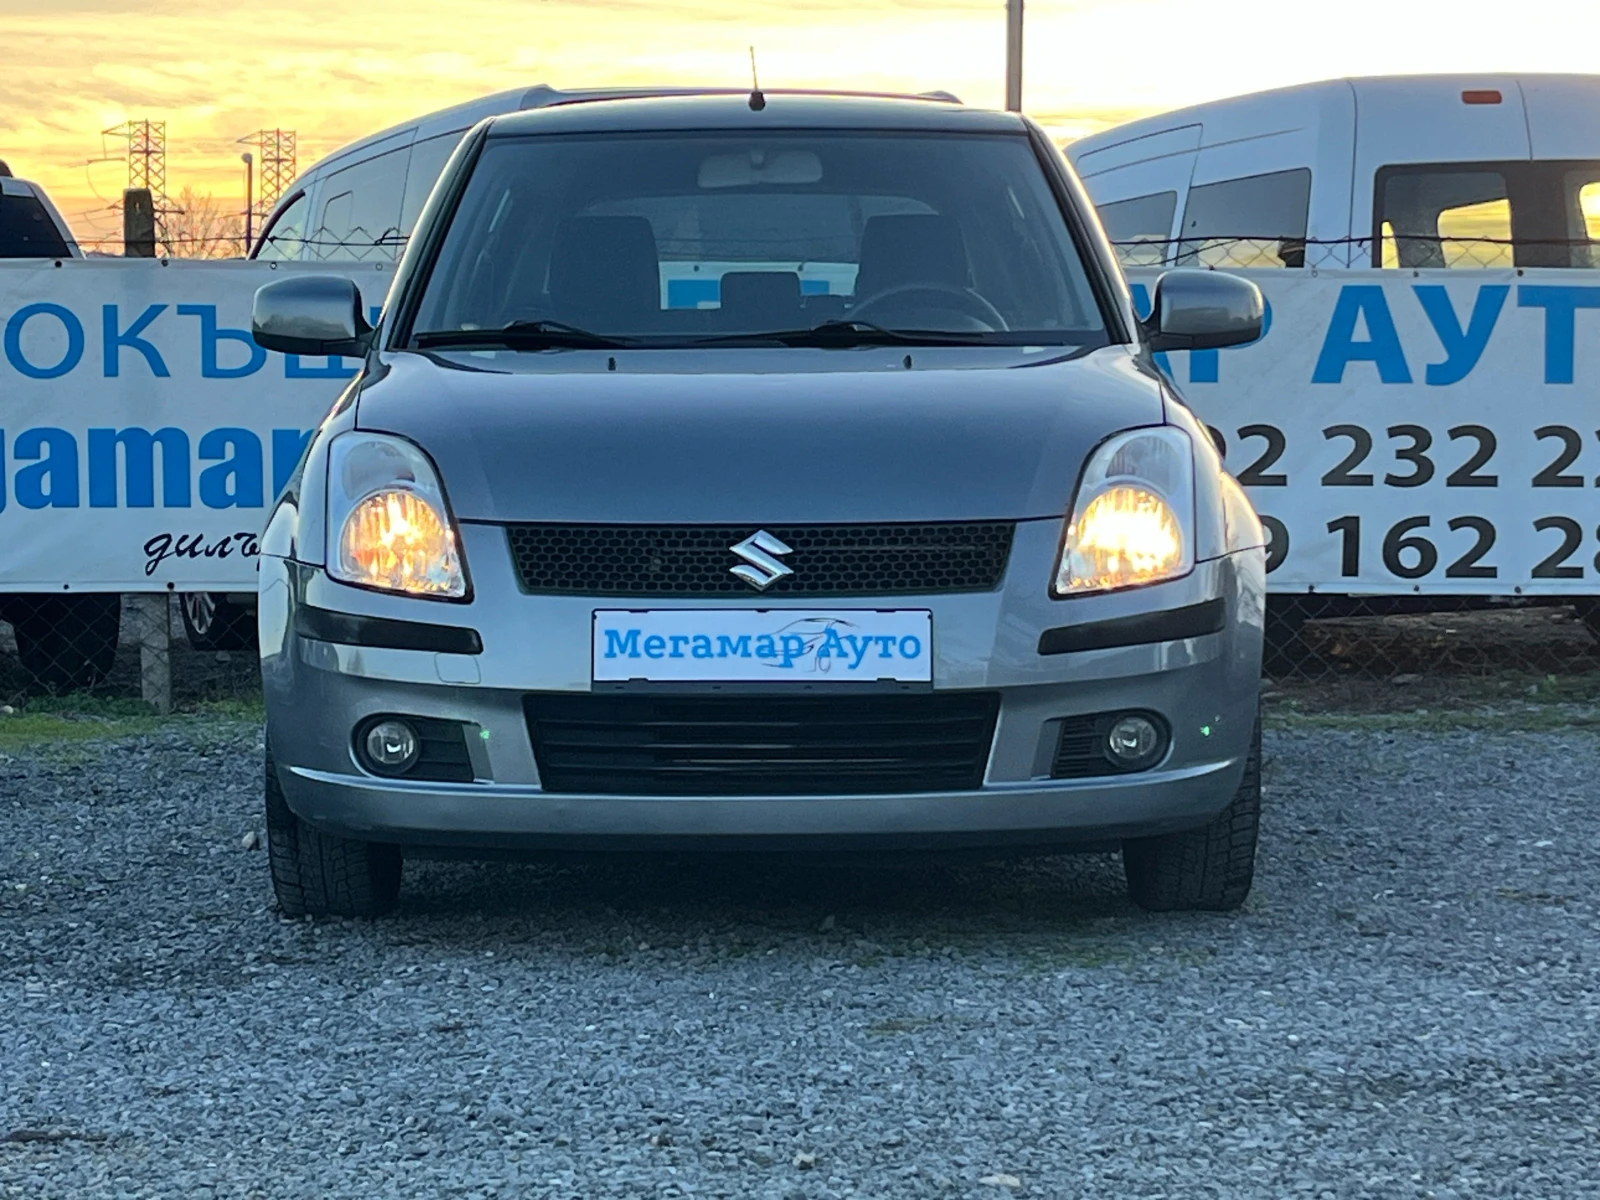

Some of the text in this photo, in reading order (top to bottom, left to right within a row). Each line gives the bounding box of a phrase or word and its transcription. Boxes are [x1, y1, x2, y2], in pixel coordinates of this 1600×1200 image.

[1311, 285, 1600, 386] АУТ
[1321, 424, 1498, 488] 232
[1531, 424, 1600, 488] 2
[143, 532, 261, 576] дилъ
[1326, 515, 1498, 579] 162
[1531, 516, 1600, 579] 2
[604, 627, 921, 669] Мегамар Ауто
